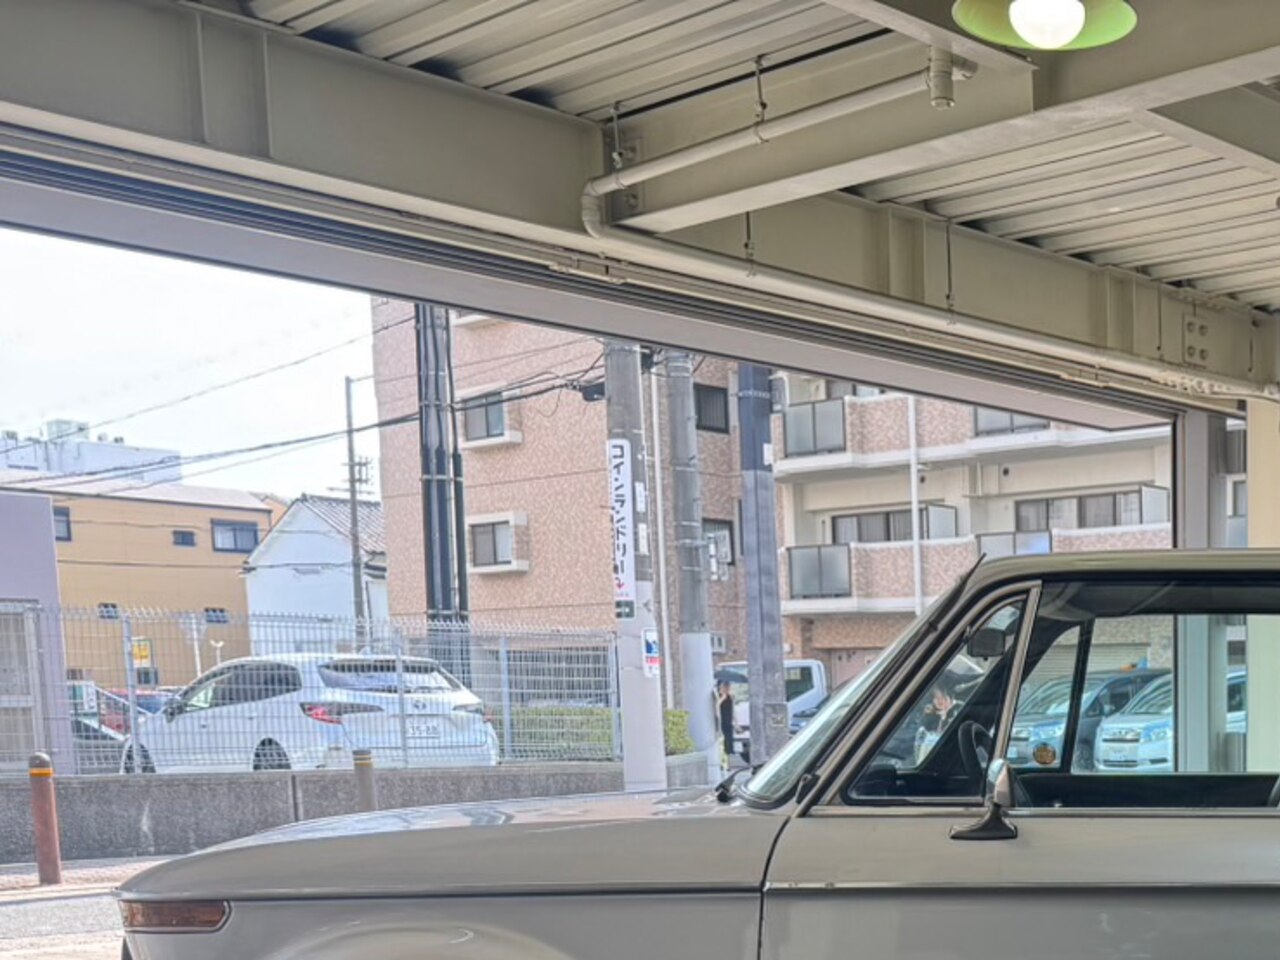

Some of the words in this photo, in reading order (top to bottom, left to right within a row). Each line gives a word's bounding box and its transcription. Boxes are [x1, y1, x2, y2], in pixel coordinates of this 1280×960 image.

[612, 444, 627, 574] コインランドリー
